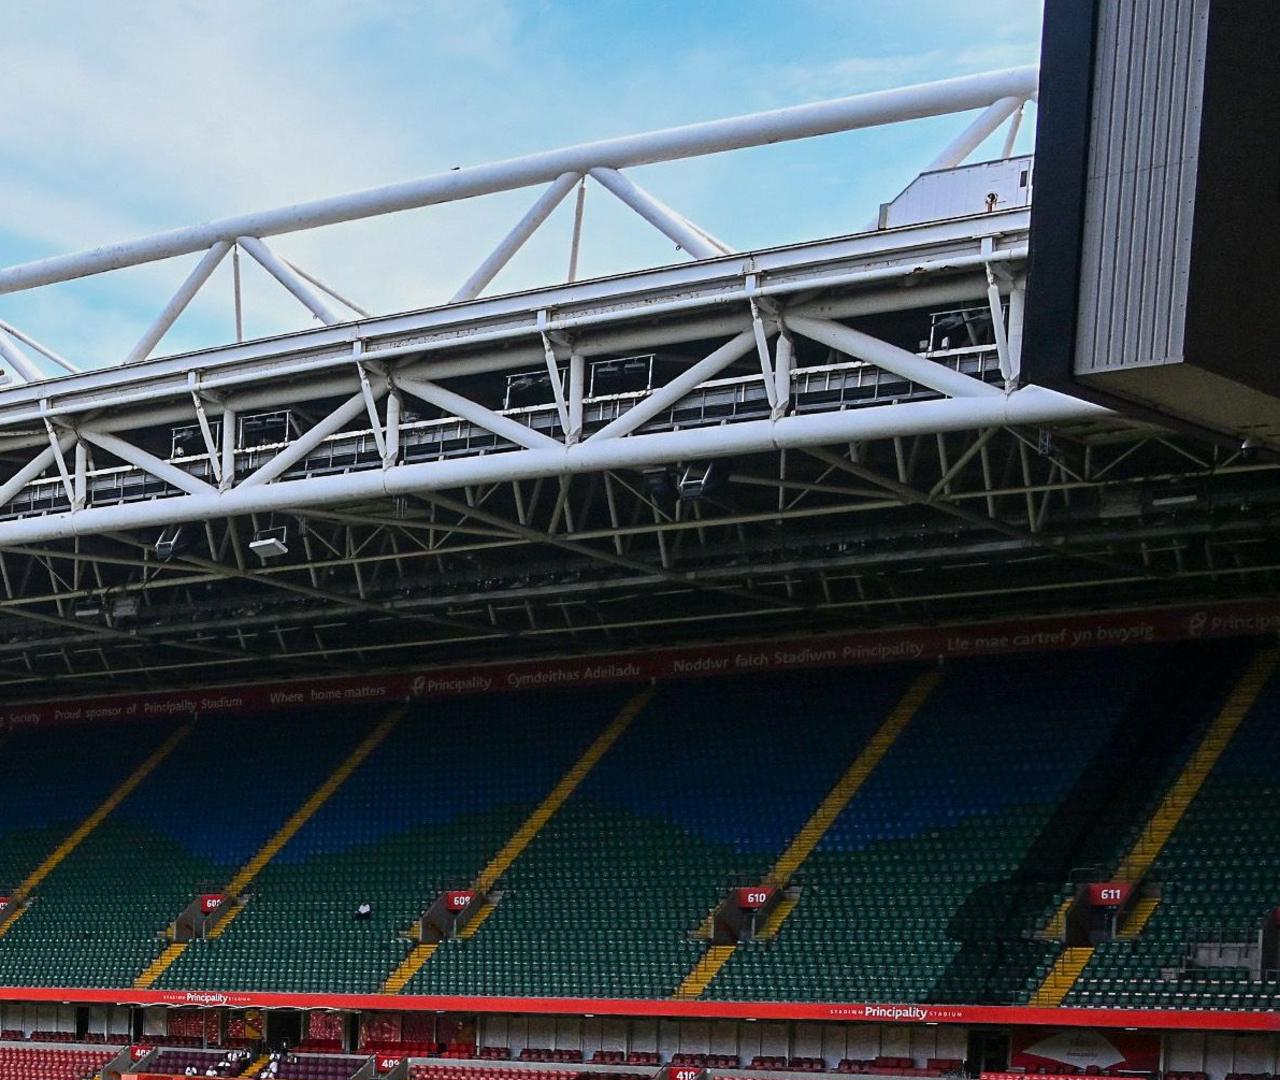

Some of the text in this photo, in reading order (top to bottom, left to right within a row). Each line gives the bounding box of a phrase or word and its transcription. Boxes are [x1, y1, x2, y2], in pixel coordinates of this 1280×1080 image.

[976, 637, 1008, 649] mae
[1013, 629, 1067, 646] cartref
[1072, 629, 1092, 644] yn
[1097, 623, 1153, 641] bwysig
[673, 658, 728, 673] Noddwr
[774, 649, 836, 666] Stadiwm
[843, 643, 924, 660] Principality
[428, 676, 492, 691] Principality
[270, 686, 385, 705] Where home matters
[55, 696, 242, 721] Proud sponsor of Principality Stadium
[748, 893, 765, 903] 610
[1101, 889, 1120, 900] 611
[187, 992, 228, 1004] Principality
[865, 1006, 927, 1020] Principality
